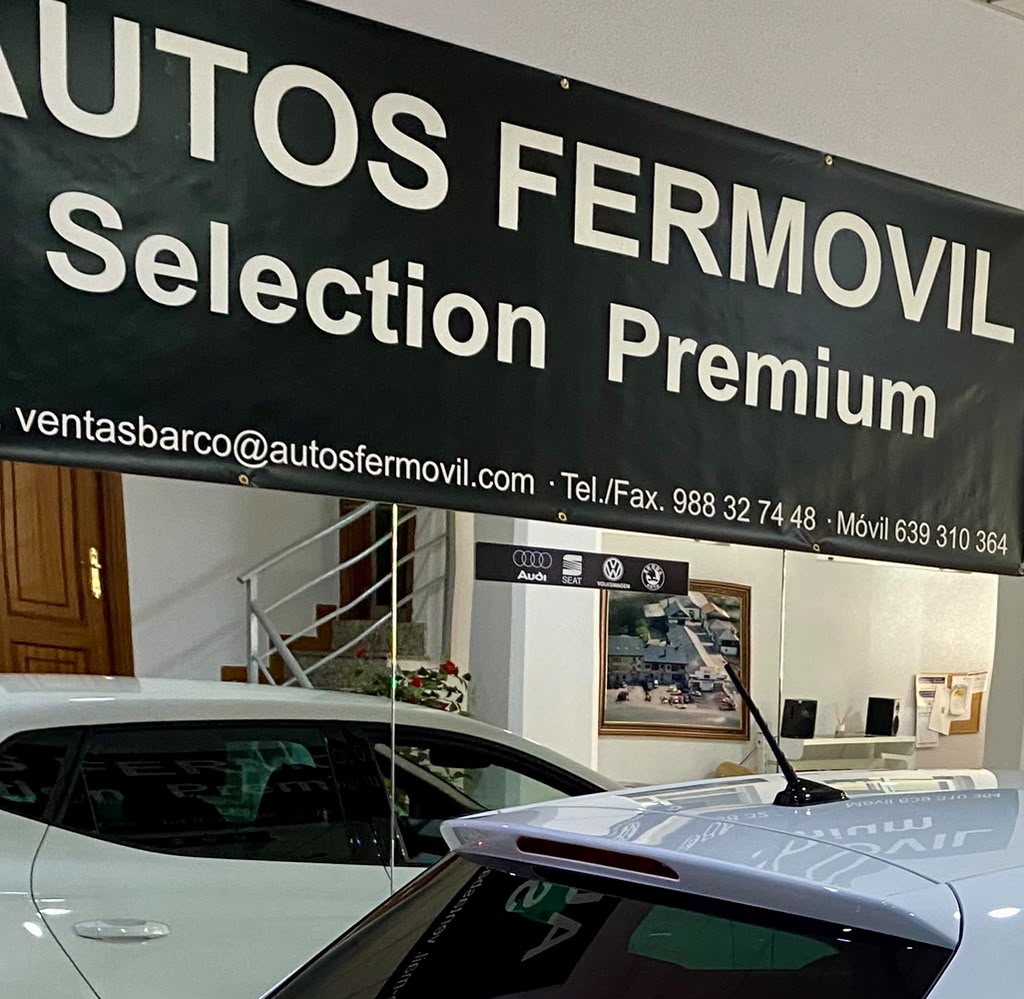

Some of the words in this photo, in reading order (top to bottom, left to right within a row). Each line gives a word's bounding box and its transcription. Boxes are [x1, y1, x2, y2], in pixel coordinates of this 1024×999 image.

[498, 121, 1015, 344] FERMOVIL
[46, 191, 546, 369] Selection
[606, 302, 937, 438] Premium
[15, 407, 535, 495] ventasbarco@autosfermovil.com
[560, 471, 664, 512] Tel./Fax.
[673, 488, 715, 517] 988
[723, 495, 750, 522] 32
[758, 500, 784, 527] 74
[790, 505, 816, 531] 48
[836, 511, 889, 541] Móvil
[895, 519, 931, 546] 639
[936, 525, 970, 550] 310
[976, 530, 1008, 556] 364
[517, 569, 547, 582] Audi
[562, 576, 582, 585] SEAT
